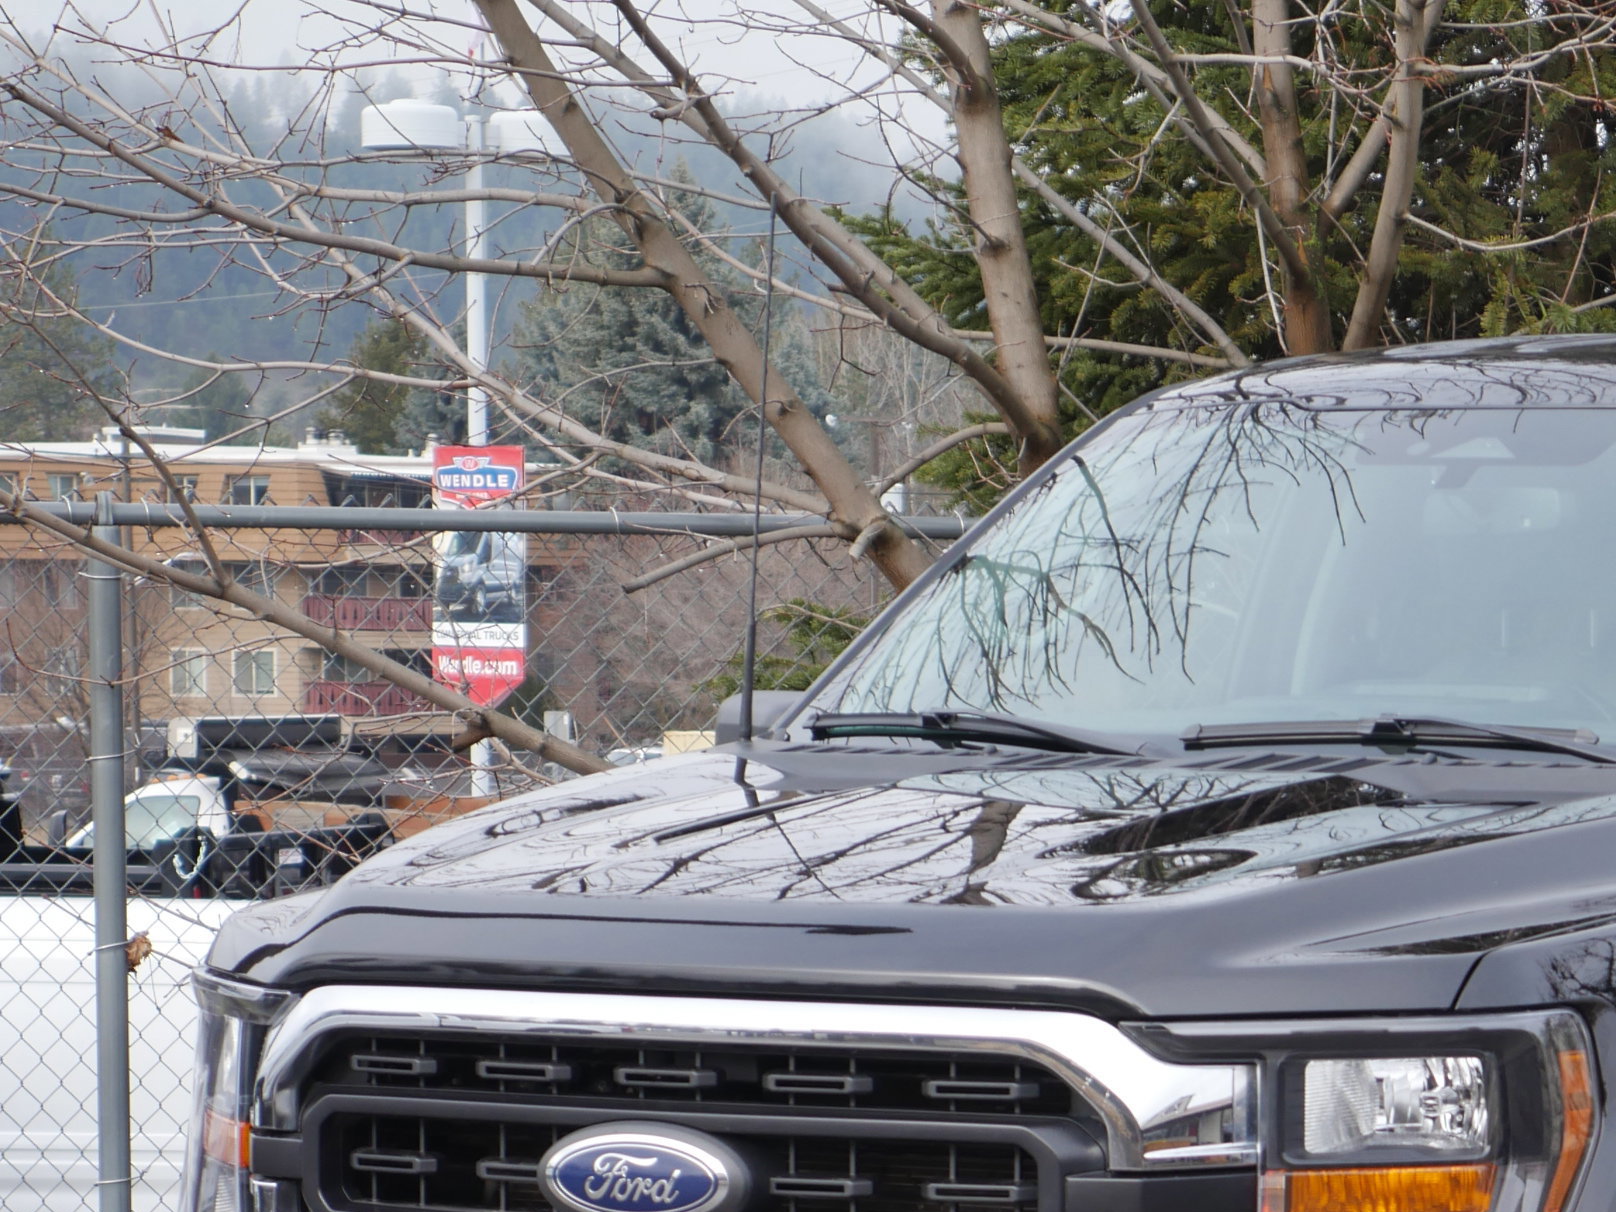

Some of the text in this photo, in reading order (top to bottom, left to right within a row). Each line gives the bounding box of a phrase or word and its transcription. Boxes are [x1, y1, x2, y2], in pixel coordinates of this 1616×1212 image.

[440, 474, 508, 487] WENDLE
[483, 630, 519, 641] TRUCKS
[584, 1153, 682, 1204] Ford
